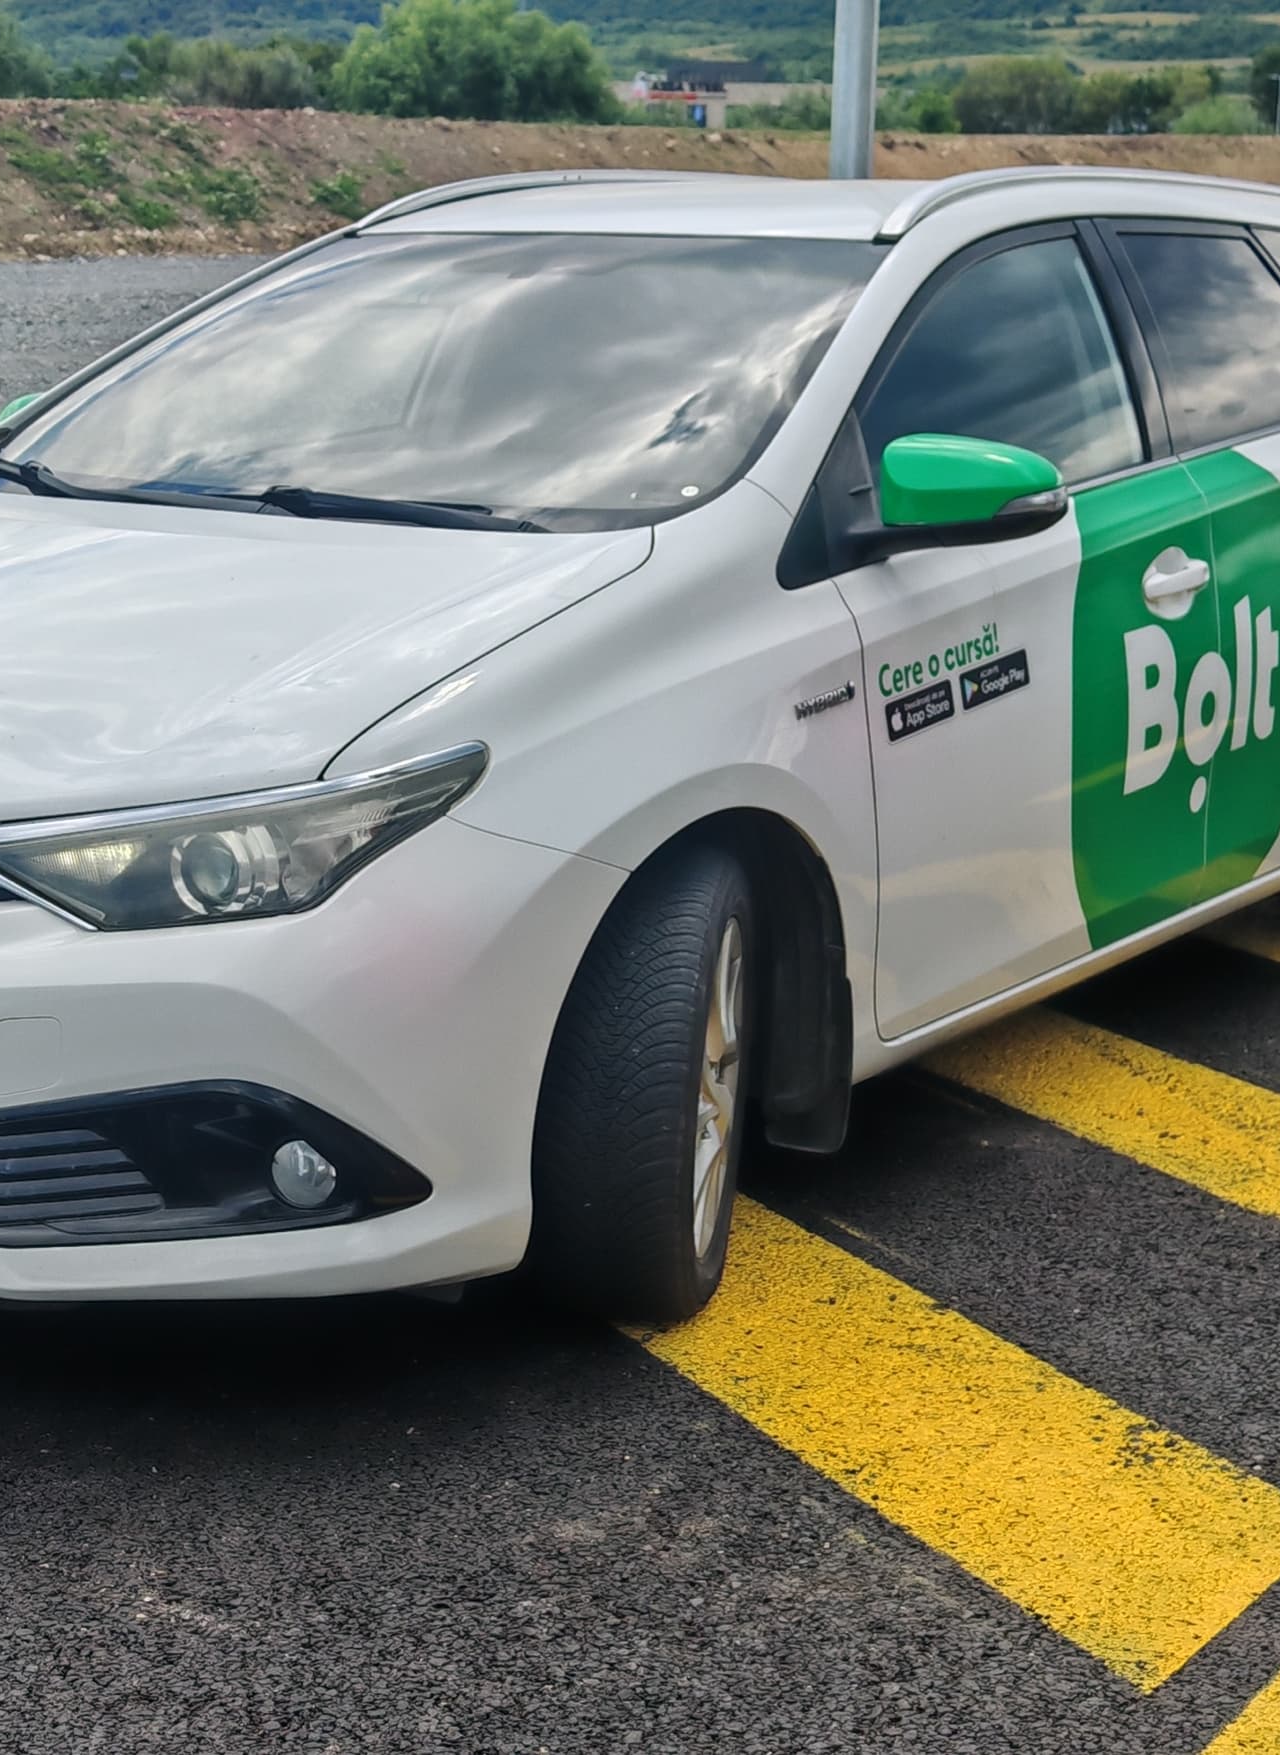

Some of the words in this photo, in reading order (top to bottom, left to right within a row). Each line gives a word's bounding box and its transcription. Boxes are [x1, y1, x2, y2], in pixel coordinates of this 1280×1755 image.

[878, 660, 923, 697] Cere
[928, 654, 940, 678] o
[944, 622, 1000, 671] cursă!
[980, 673, 1010, 695] Google
[906, 711, 925, 728] App
[925, 699, 950, 719] Store
[1123, 594, 1280, 796] Bolt
